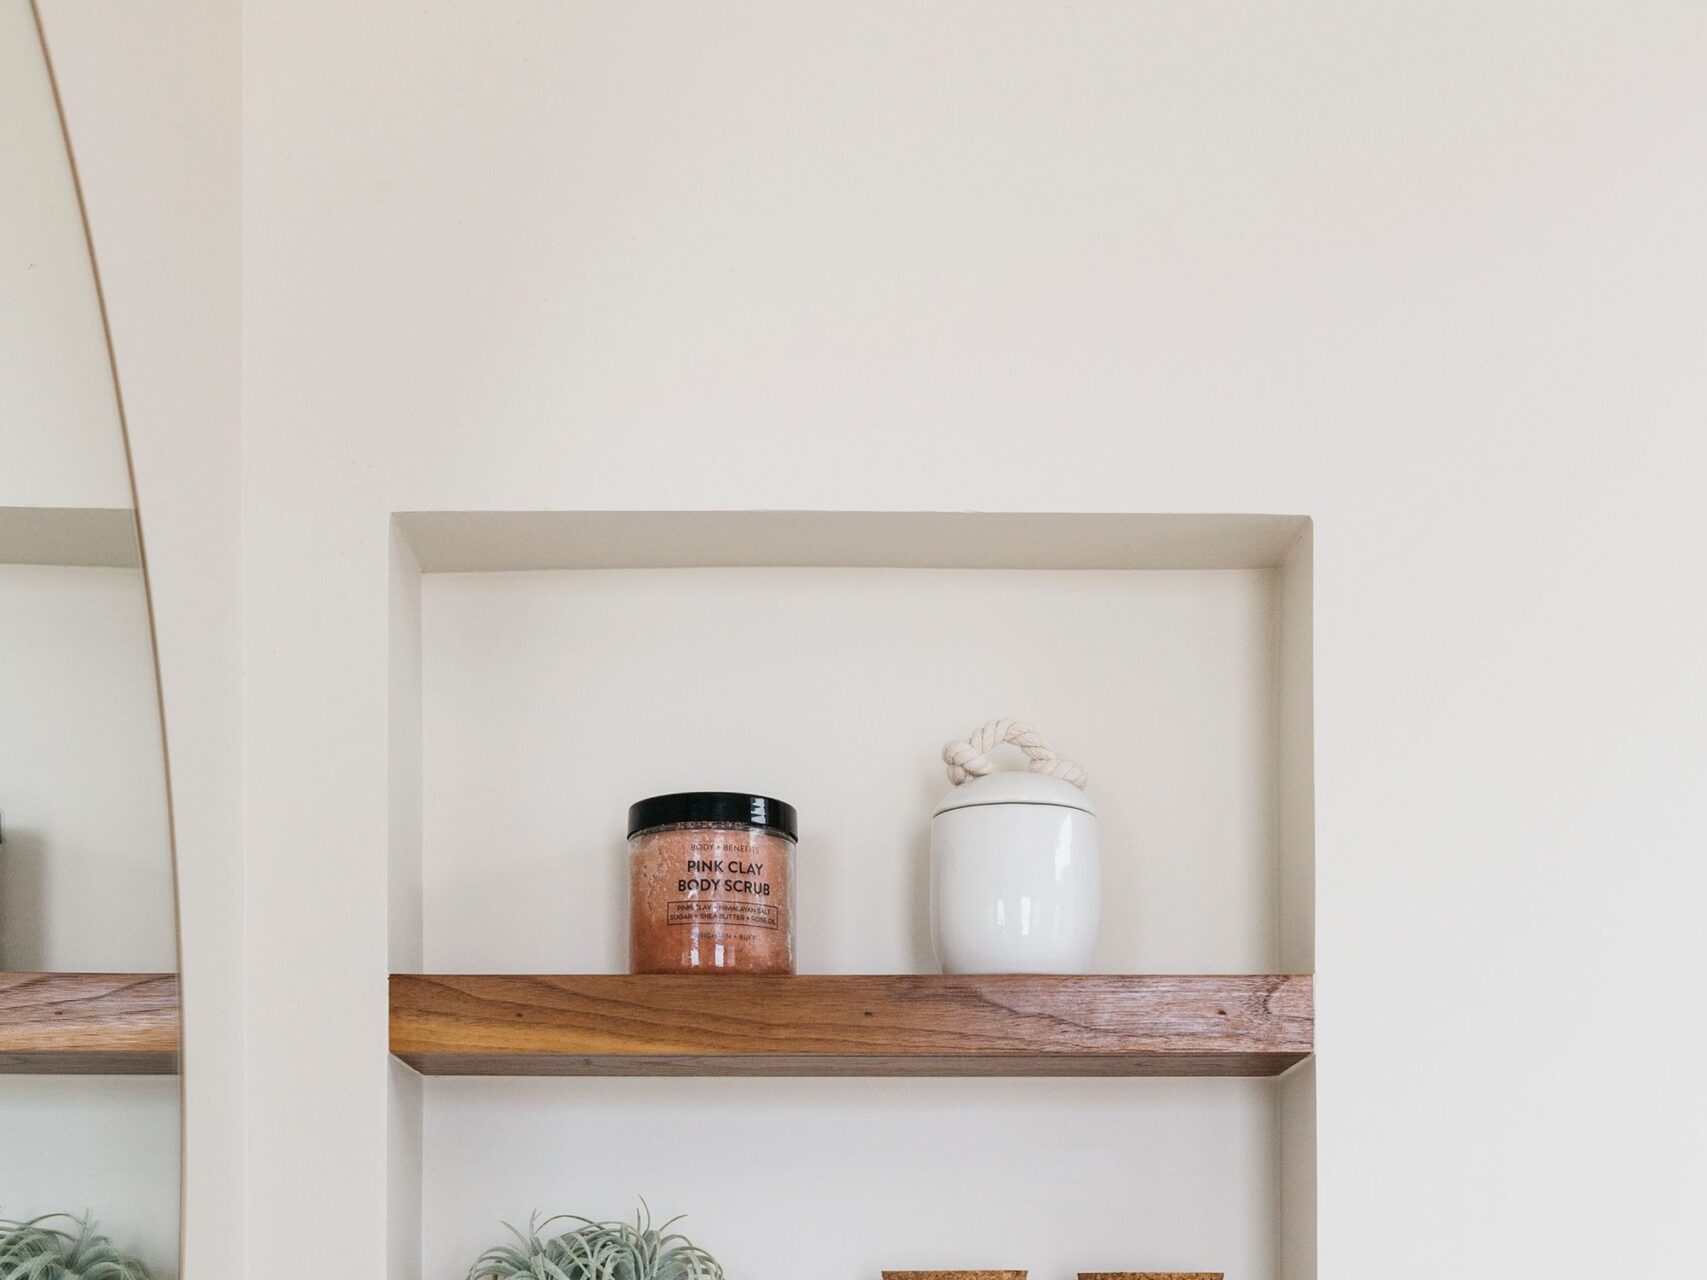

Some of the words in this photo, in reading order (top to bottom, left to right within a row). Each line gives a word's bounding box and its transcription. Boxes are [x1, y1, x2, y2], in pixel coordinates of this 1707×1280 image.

[687, 860, 724, 873] PINK
[728, 861, 764, 876] CLAY
[678, 879, 720, 892] BODY
[724, 880, 770, 896] SCRUB
[670, 913, 693, 921] SUGAR
[719, 913, 745, 921] BUTTER
